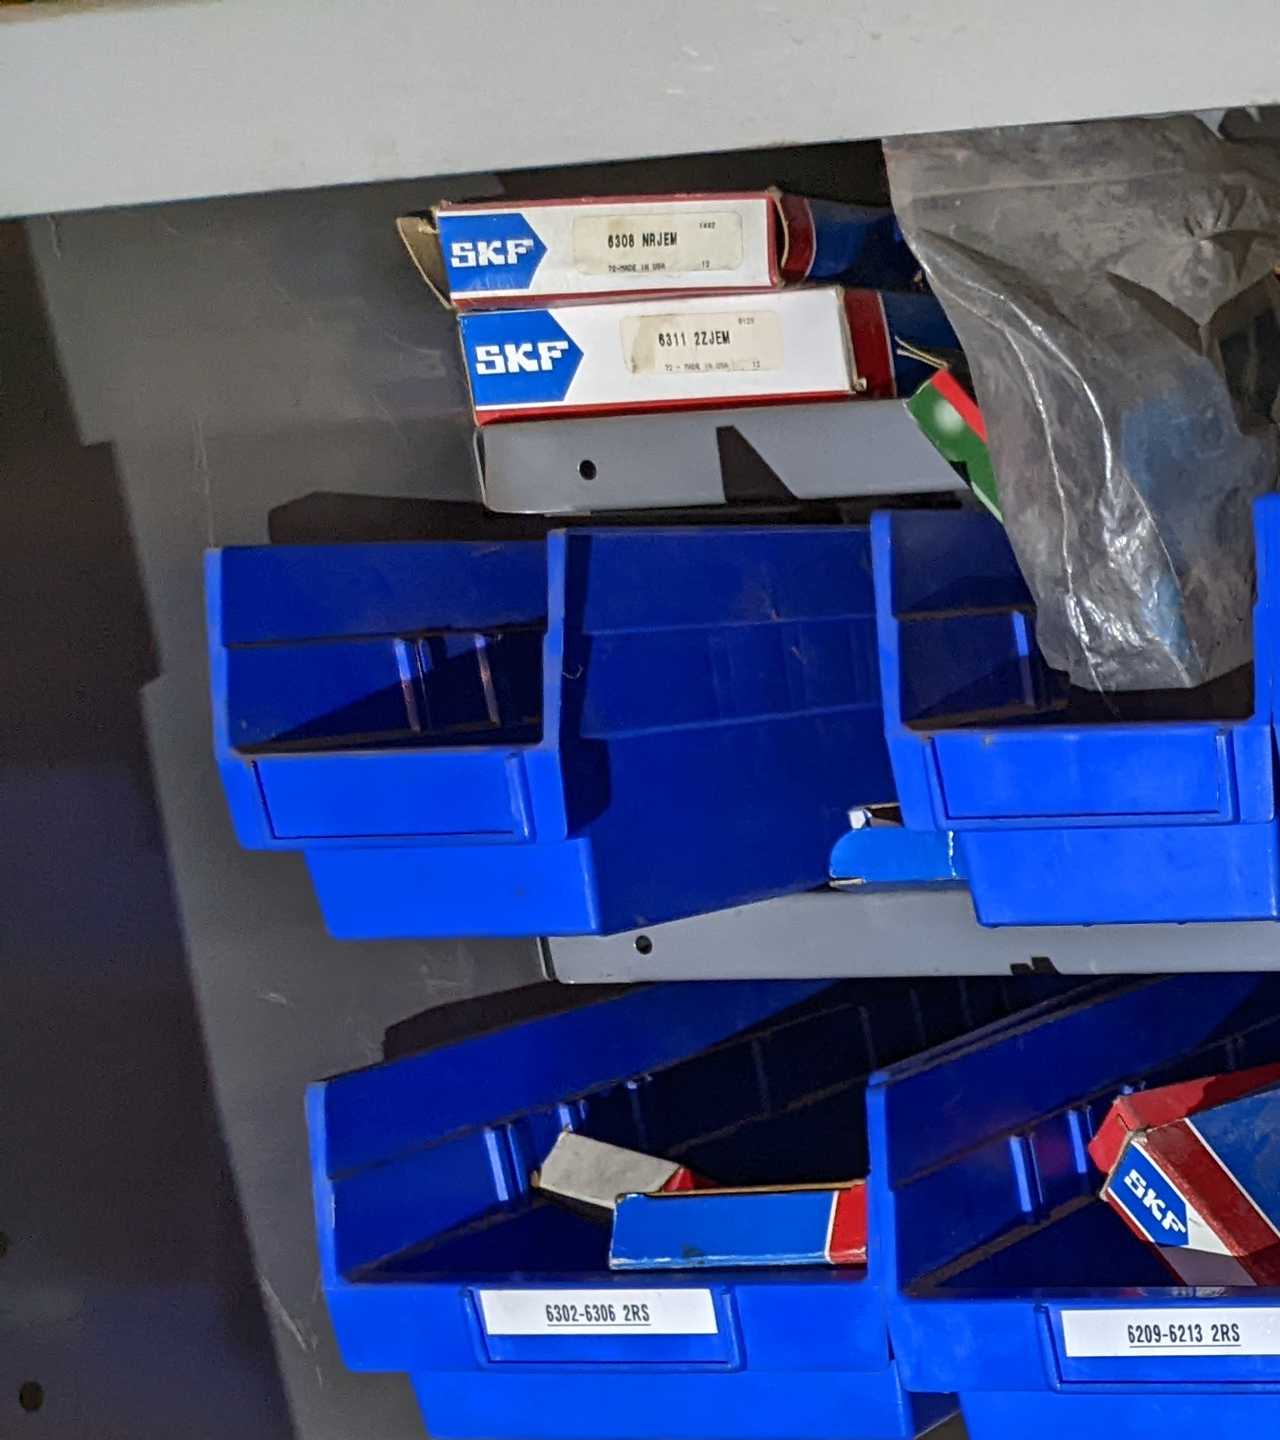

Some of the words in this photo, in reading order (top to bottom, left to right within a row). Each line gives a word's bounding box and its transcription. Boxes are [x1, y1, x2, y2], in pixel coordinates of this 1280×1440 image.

[608, 235, 635, 249] 6308
[642, 232, 678, 247] NRJEM
[451, 239, 534, 268] SKF
[658, 332, 687, 347] 6311
[695, 330, 731, 346] 2ZJEM
[475, 339, 569, 376] SKF
[1123, 1167, 1187, 1235] SKF
[546, 1303, 616, 1323] 6302-6306
[624, 1303, 650, 1322] 2RS
[1127, 1323, 1204, 1344] 6209-6213
[1211, 1323, 1241, 1343] 2RS
